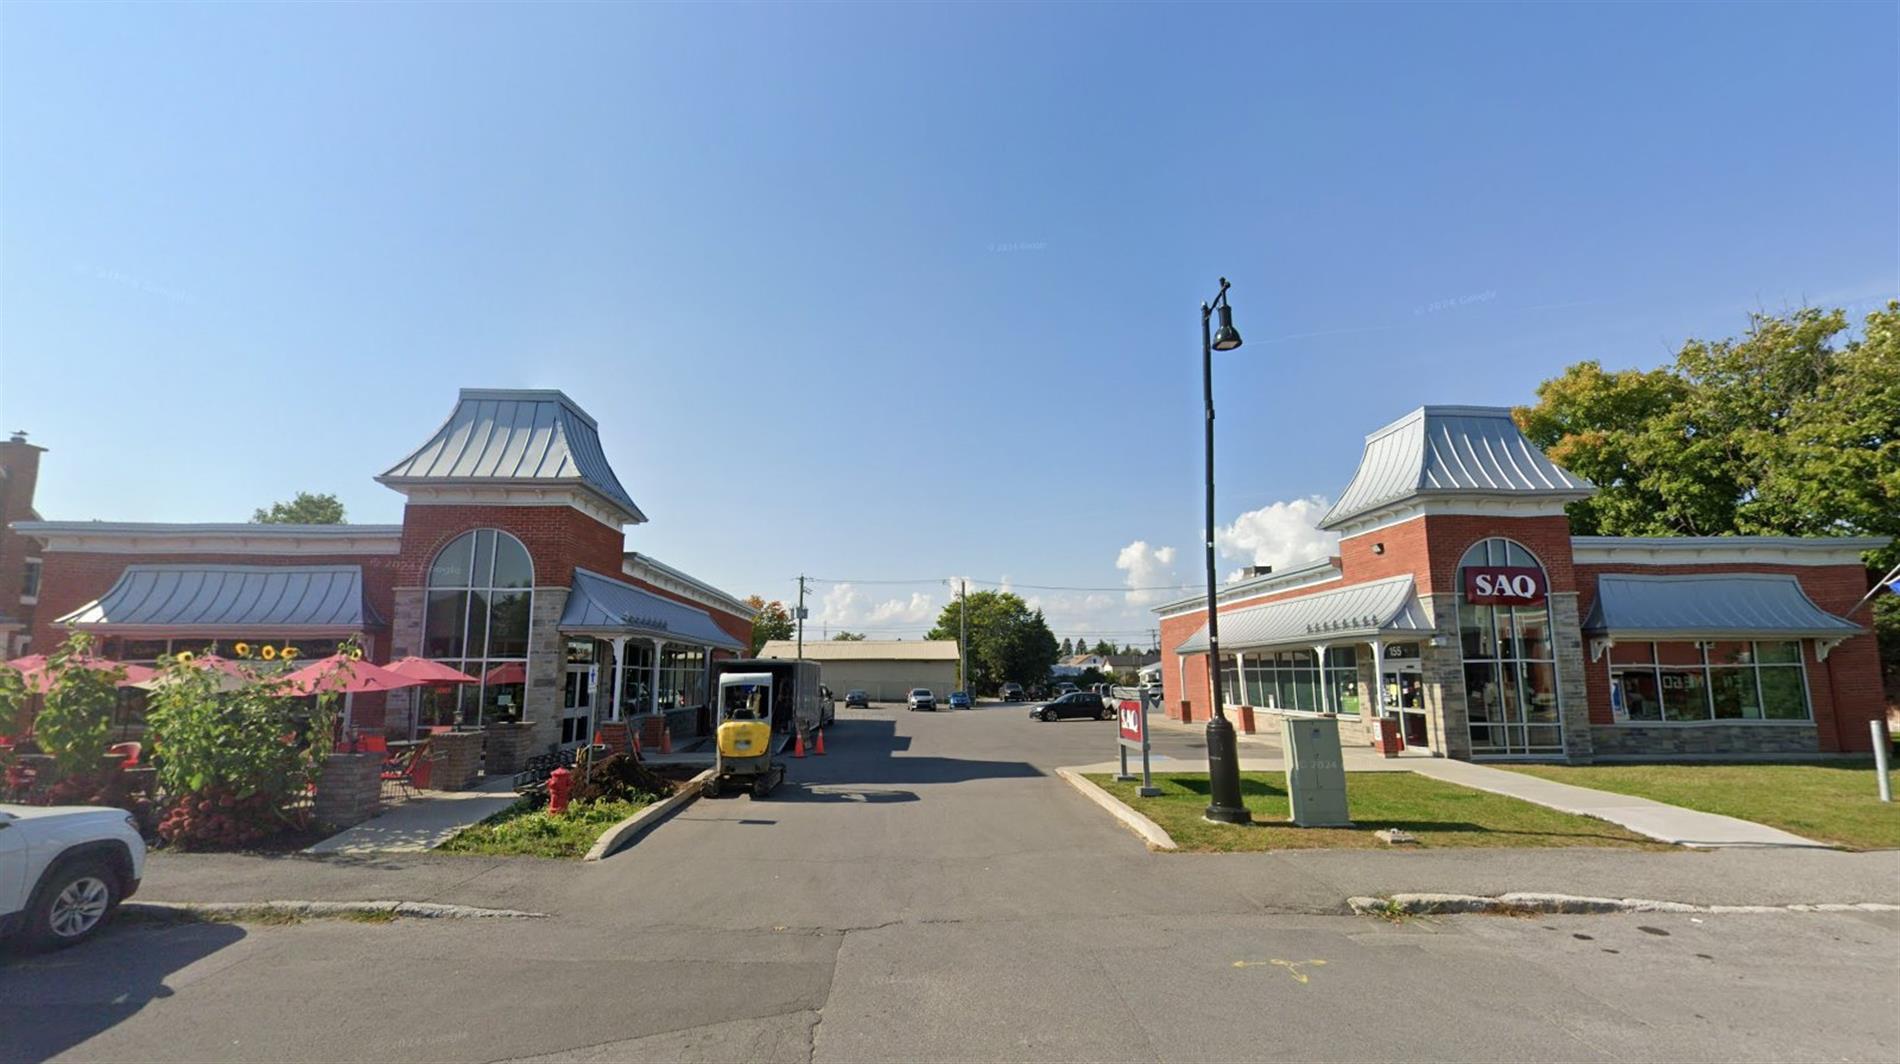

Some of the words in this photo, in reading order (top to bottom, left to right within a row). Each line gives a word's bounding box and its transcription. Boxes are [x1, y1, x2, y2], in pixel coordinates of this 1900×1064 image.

[1475, 574, 1537, 599] SAQ
[1388, 645, 1402, 657] 155
[1120, 708, 1139, 733] SAQ
